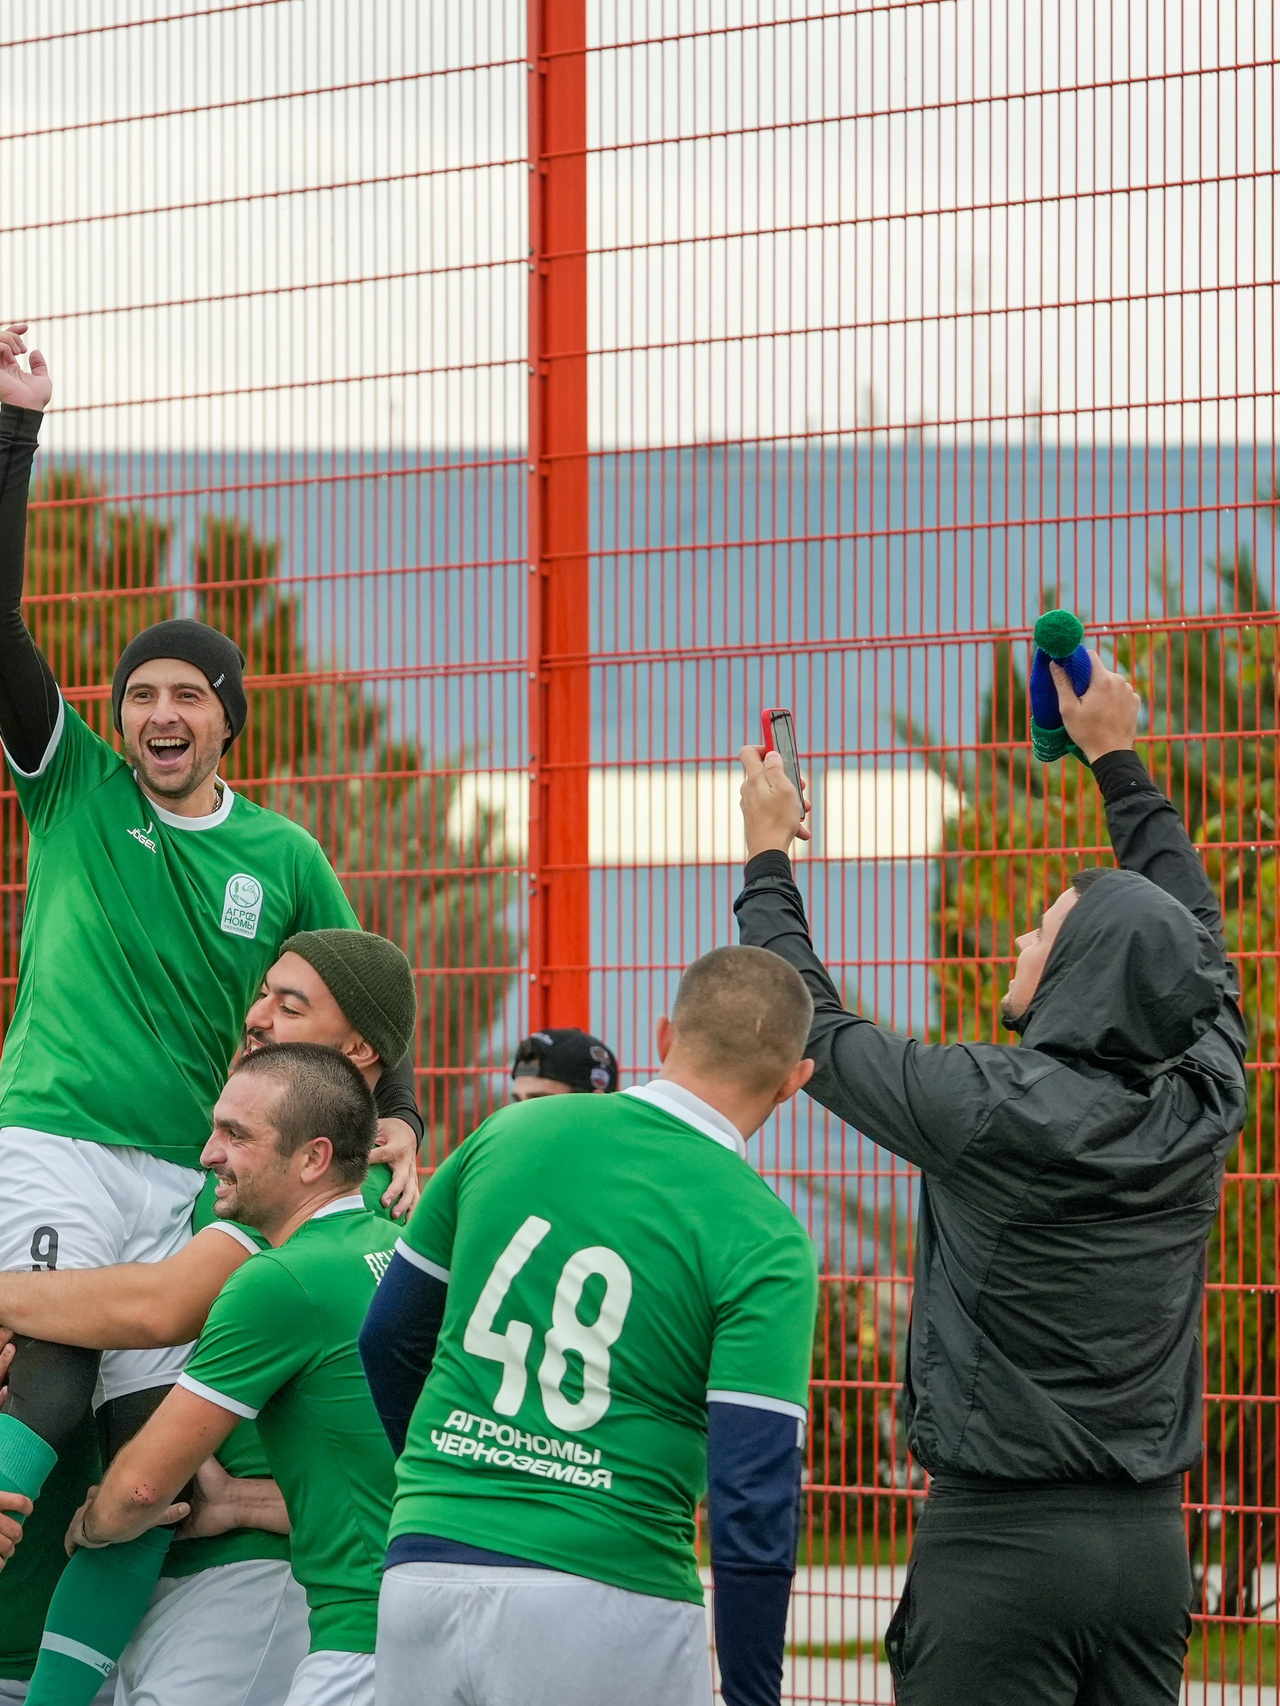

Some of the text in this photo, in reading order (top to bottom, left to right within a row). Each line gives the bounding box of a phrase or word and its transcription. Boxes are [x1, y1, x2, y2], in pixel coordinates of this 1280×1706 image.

[224, 915, 255, 930] НОМЫ
[31, 1226, 58, 1271] 9
[463, 1215, 632, 1431] 48
[430, 1429, 612, 1489] ЧЕРНОЗЕМЬЯ
[444, 1409, 601, 1465] АГРОНОМЫ
